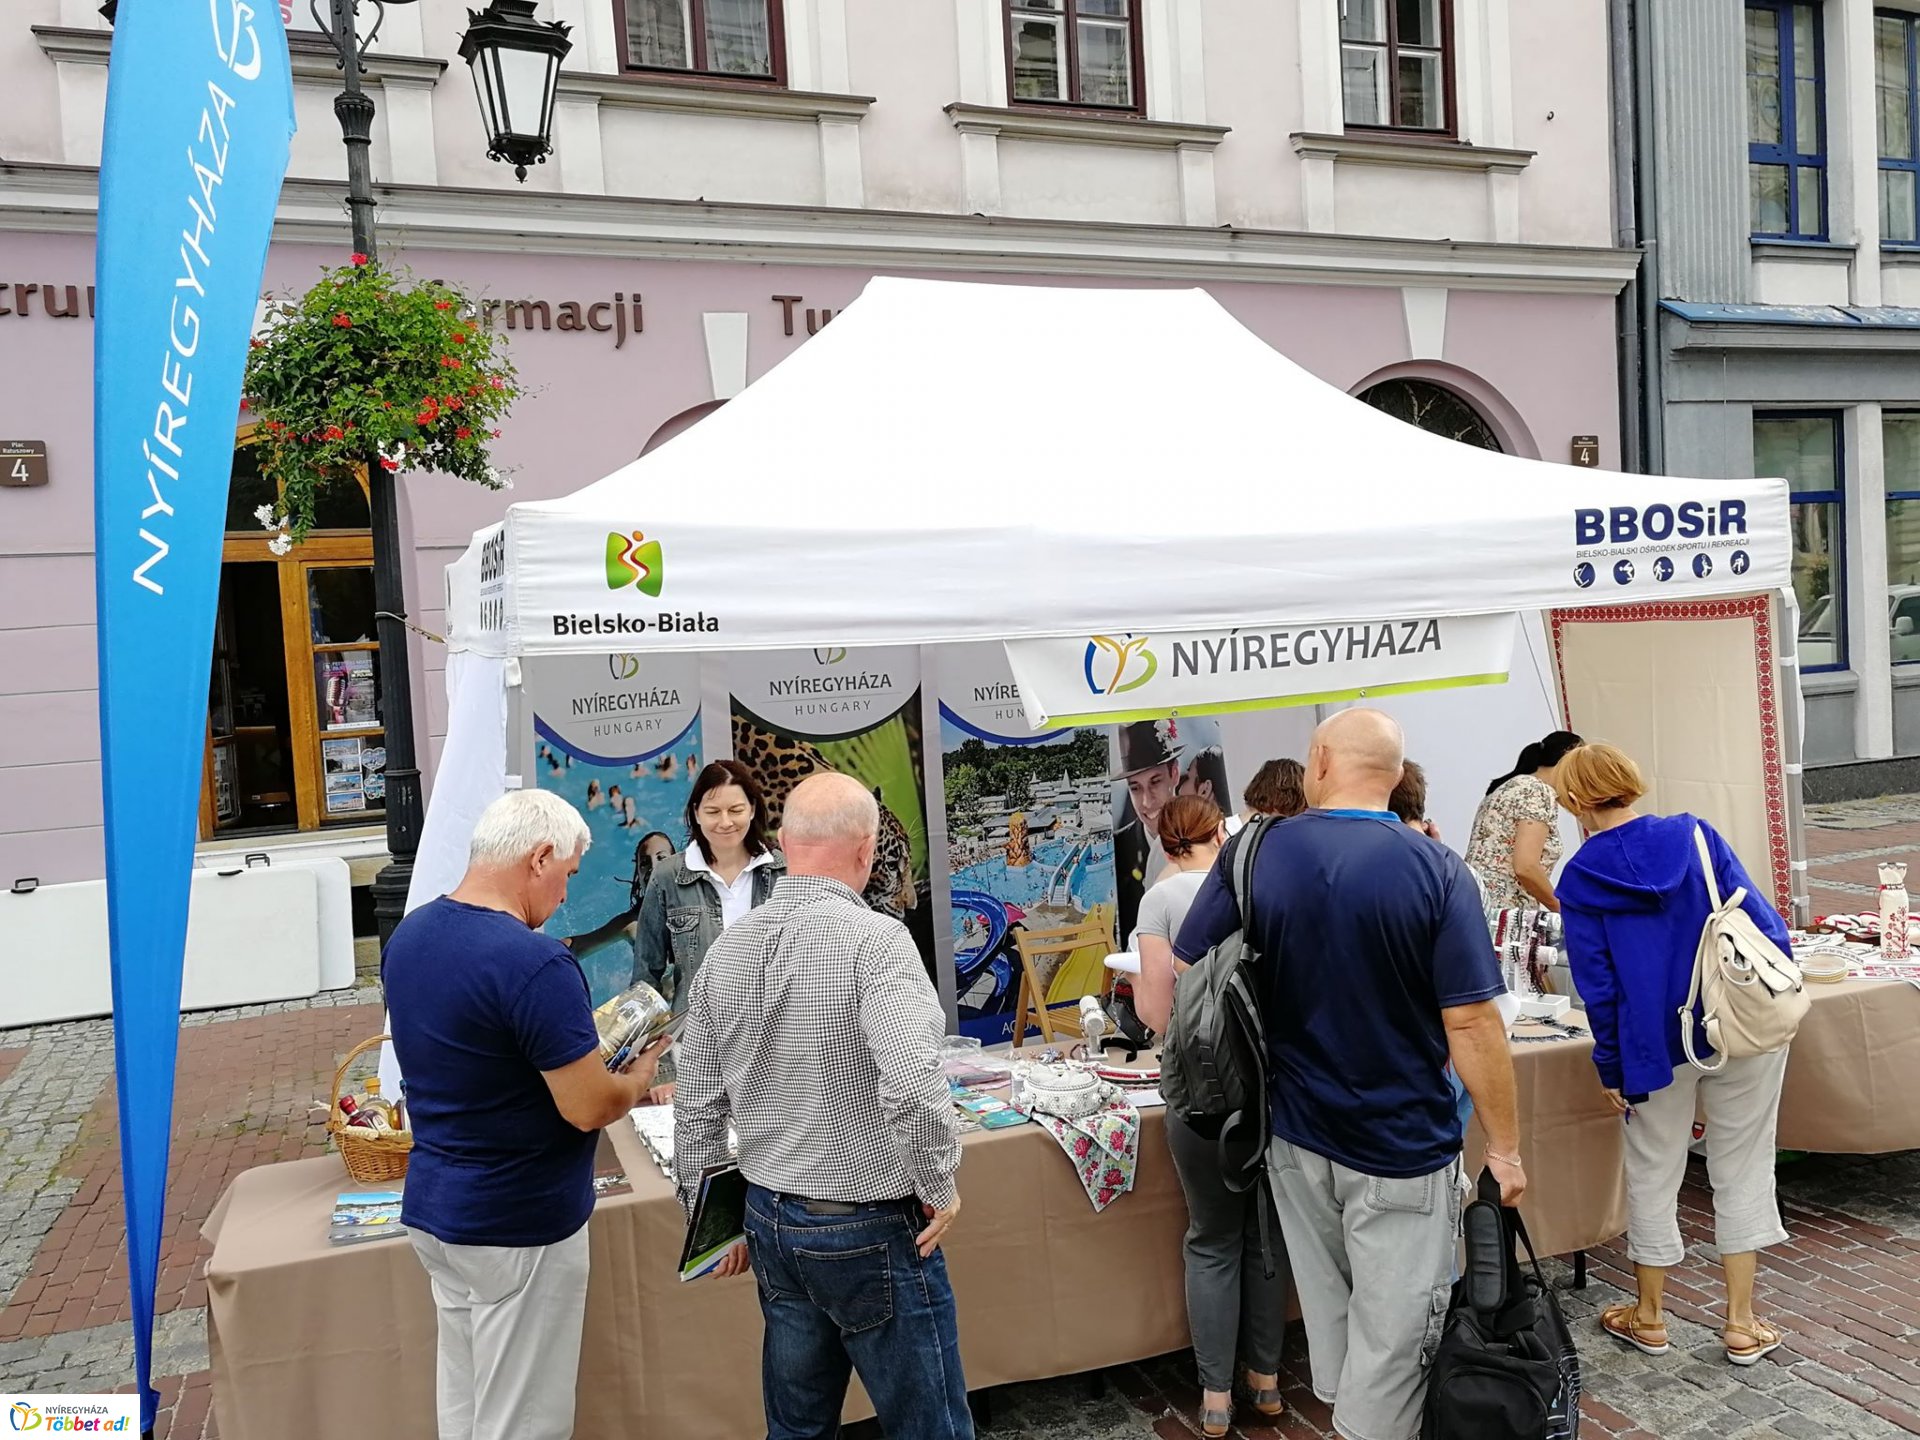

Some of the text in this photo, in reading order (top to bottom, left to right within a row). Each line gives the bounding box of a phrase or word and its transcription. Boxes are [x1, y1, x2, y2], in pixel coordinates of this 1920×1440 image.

[482, 292, 643, 350] rmacji
[772, 295, 843, 336] Tu
[133, 80, 236, 595] NYÍREGYHÁZA
[1580, 447, 1590, 464] 4
[11, 458, 29, 482] 4
[1575, 499, 1748, 546] BBOSiR
[1576, 547, 1639, 559] BIELSKO-BIALSKI
[1639, 543, 1676, 554] OŚRODEK
[1676, 541, 1707, 551] SPORTU
[1712, 538, 1750, 549] REKREACJI
[553, 611, 720, 636] Bielsko-Biała
[769, 671, 893, 697] NYÍREGYHÁZA
[974, 682, 1021, 702] NYÍRE
[572, 687, 681, 716] NYÍREGYHÁZA
[794, 700, 872, 716] HUNGARY
[995, 707, 1025, 720] HUN
[593, 718, 663, 737] HUNGARY
